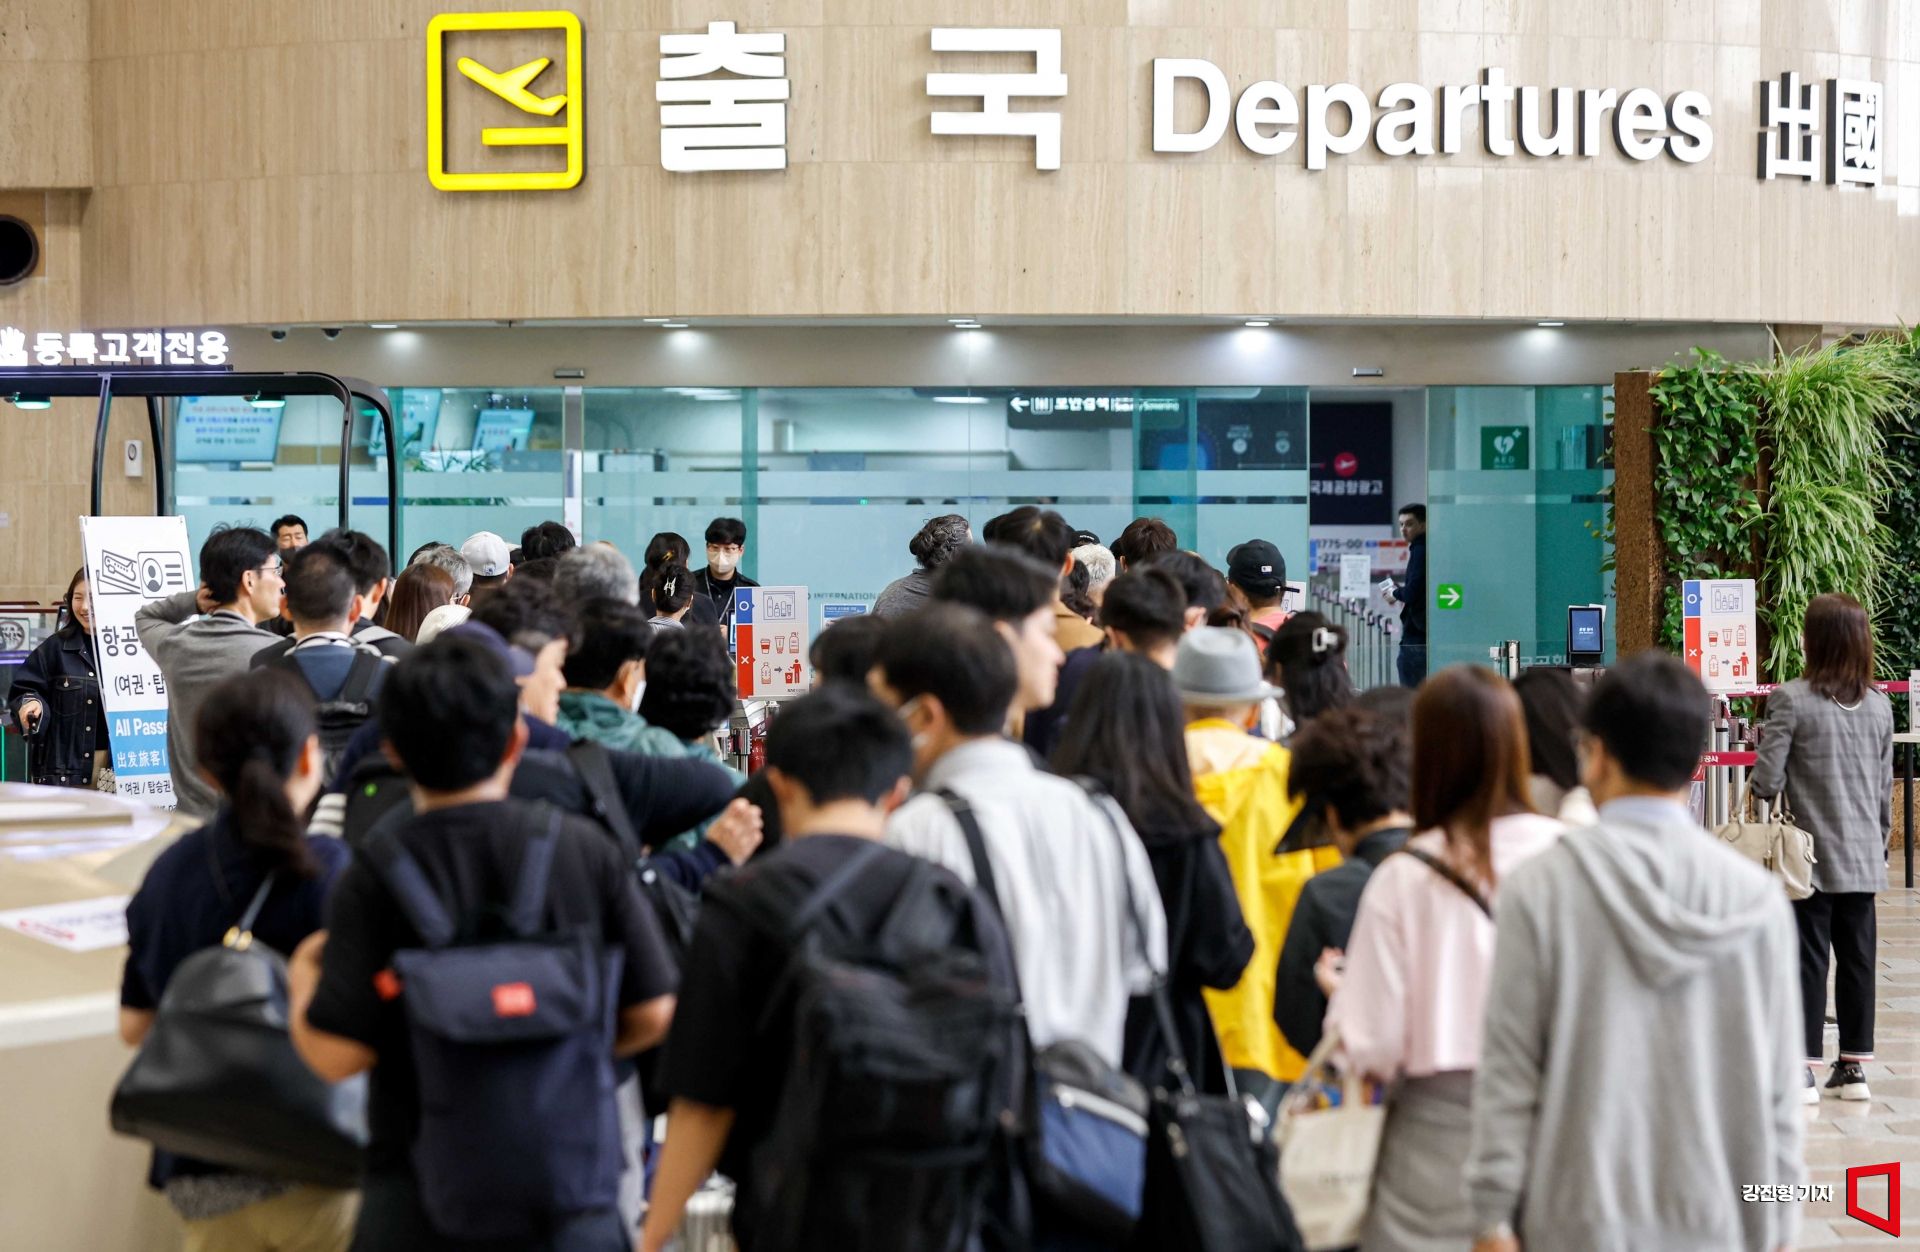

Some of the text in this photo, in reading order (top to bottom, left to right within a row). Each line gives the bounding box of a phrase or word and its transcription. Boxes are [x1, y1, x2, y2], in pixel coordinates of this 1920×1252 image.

[1152, 57, 1713, 170] Departures
[1762, 71, 1884, 189] 出國
[814, 592, 880, 601] INTERNATION
[102, 625, 142, 657] 항공
[116, 719, 131, 737] All
